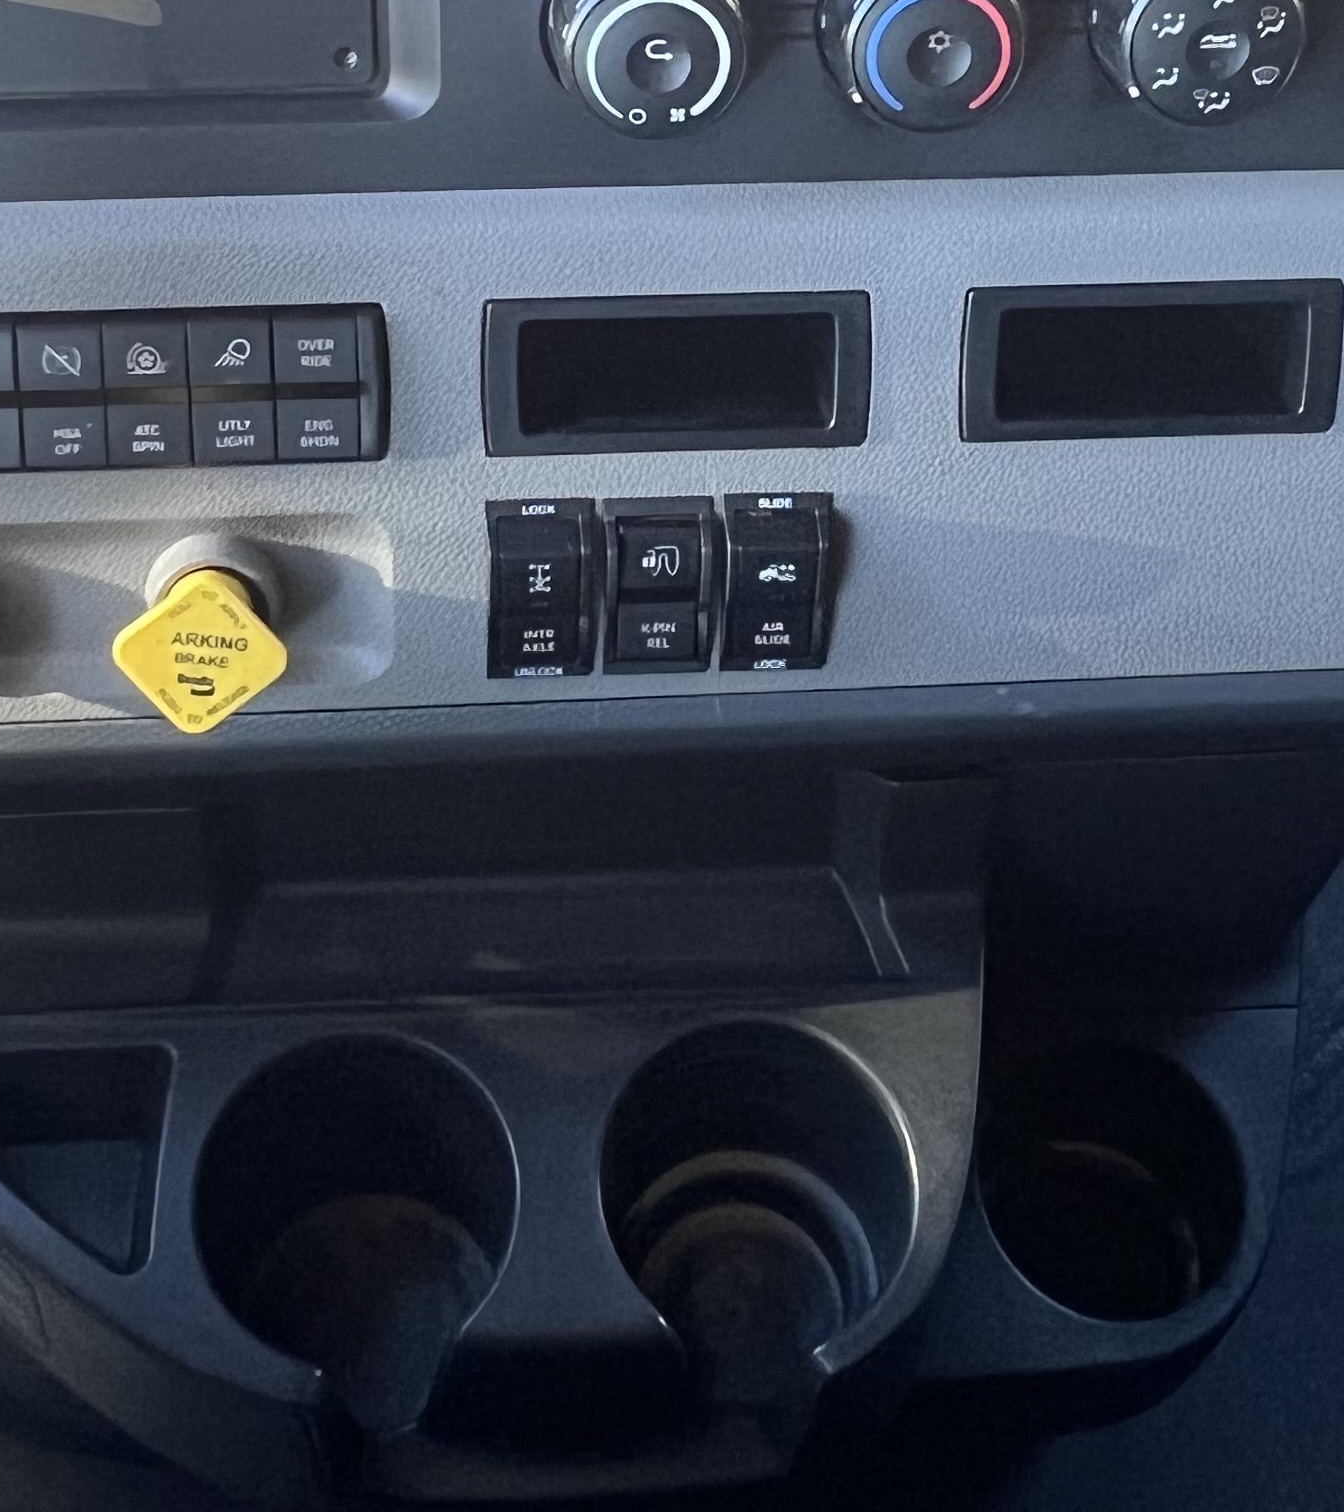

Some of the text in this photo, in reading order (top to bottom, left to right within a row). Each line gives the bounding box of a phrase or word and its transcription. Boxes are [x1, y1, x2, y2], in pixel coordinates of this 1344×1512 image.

[297, 339, 334, 351] OVER
[216, 435, 255, 448] LIGHT
[174, 652, 229, 669] BRAKE
